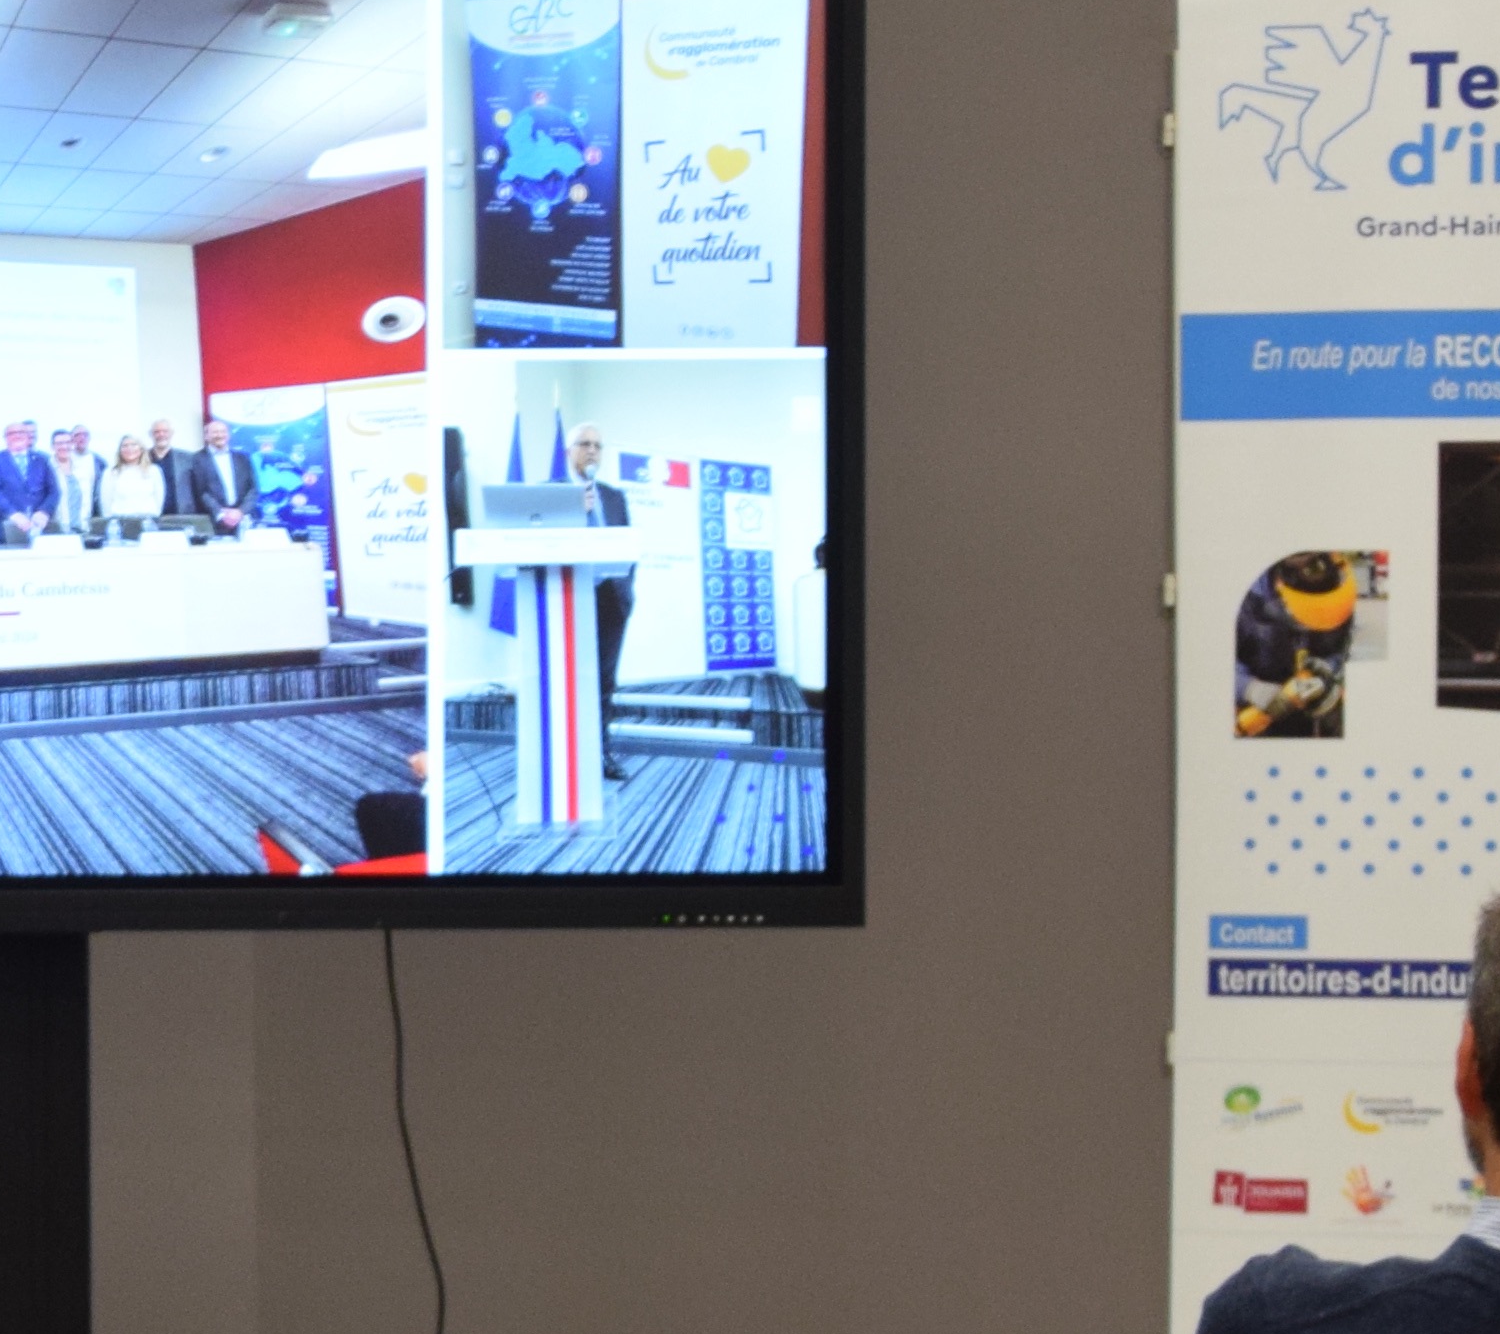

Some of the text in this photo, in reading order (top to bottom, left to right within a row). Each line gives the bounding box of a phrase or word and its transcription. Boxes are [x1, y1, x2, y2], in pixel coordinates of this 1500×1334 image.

[657, 154, 701, 189] Au
[658, 191, 750, 224] de votre
[661, 231, 761, 274] quotidien
[1252, 340, 1283, 371] En
[1288, 338, 1342, 370] route
[1348, 345, 1400, 376] pour
[1406, 337, 1427, 367] la
[1431, 377, 1460, 401] de
[1219, 923, 1295, 944] Contact
[1218, 963, 1473, 994] territoires-d-indu
